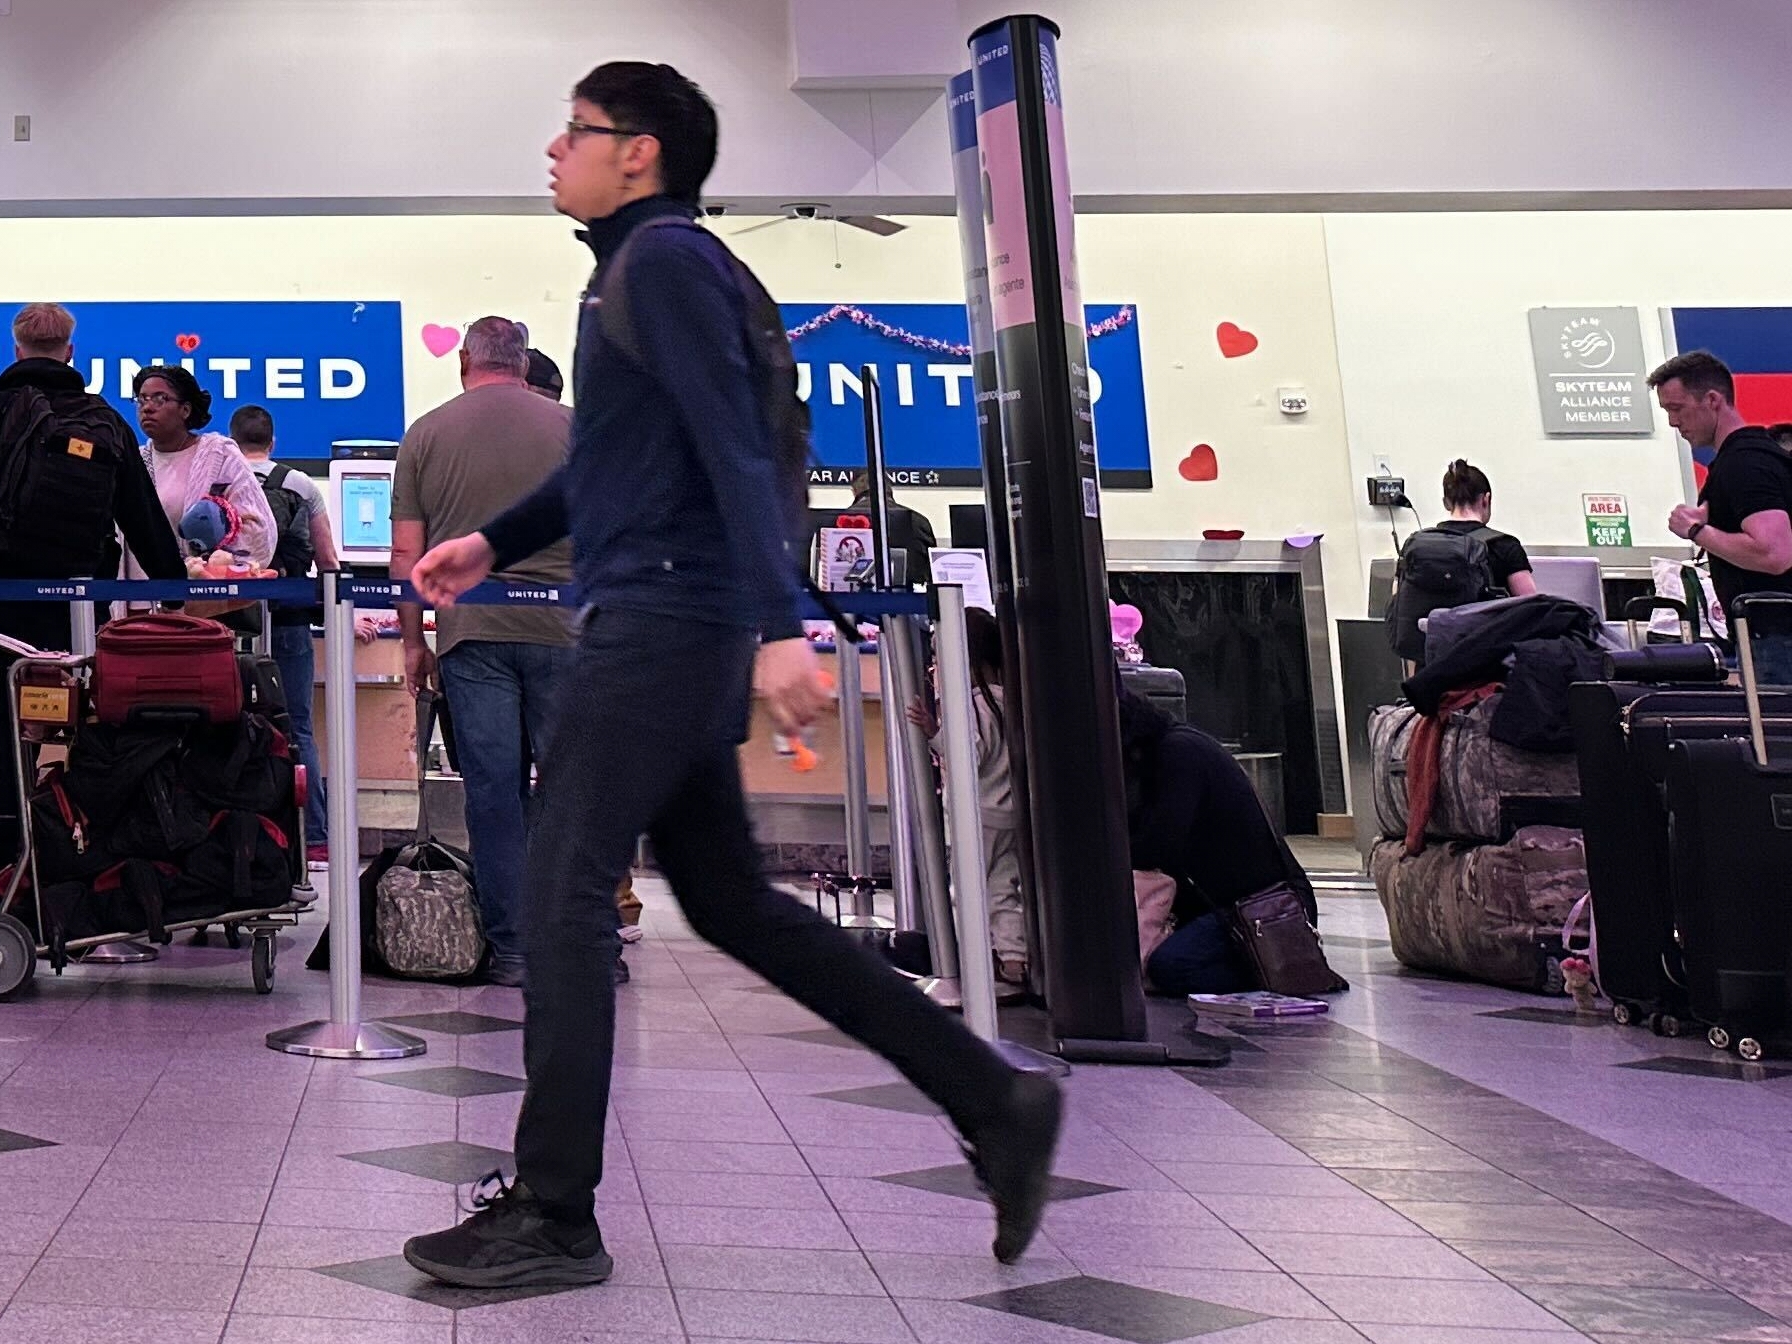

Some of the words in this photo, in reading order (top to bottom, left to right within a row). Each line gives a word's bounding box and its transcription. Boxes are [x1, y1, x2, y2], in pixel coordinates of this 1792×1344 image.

[977, 44, 1009, 66] UNITED
[1560, 317, 1601, 359] SKYTEAM
[1554, 381, 1633, 393] SKYTEAM
[1560, 396, 1633, 408] ALLIANCE
[1564, 411, 1632, 423] MEMBER
[837, 471, 921, 484] ANCE
[1589, 503, 1623, 514] AREA
[1591, 527, 1626, 537] KEEP
[1596, 535, 1624, 546] OUT
[189, 586, 228, 594] UNITED
[351, 585, 390, 594] UNITED
[507, 590, 548, 598] UNITED
